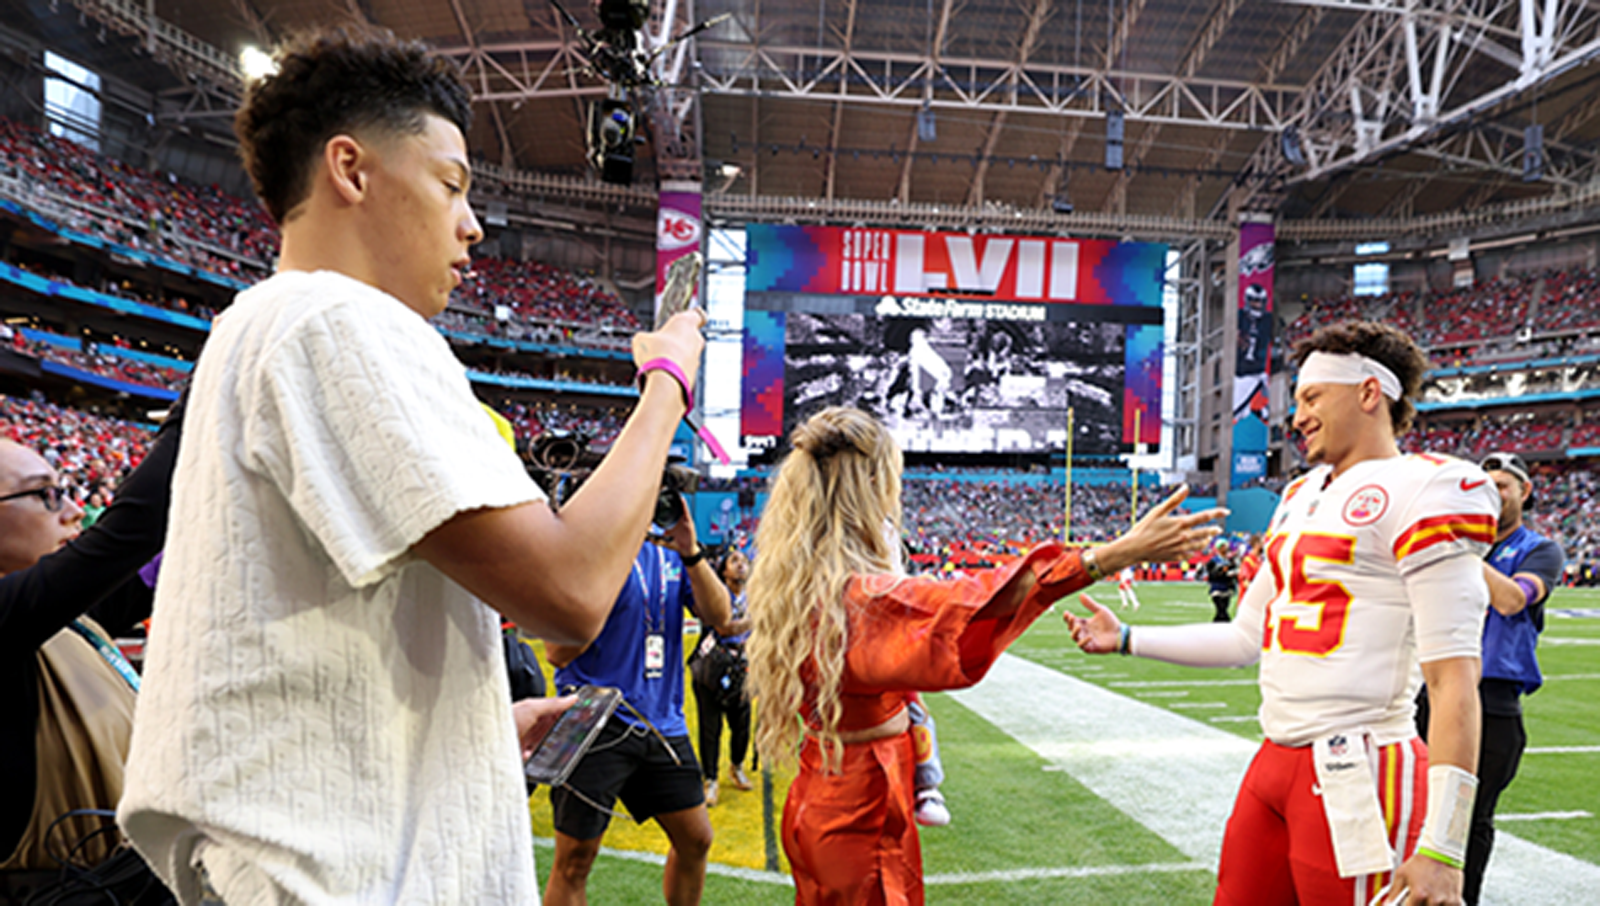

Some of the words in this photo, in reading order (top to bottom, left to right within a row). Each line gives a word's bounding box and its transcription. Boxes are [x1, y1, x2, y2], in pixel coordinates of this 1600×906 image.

[843, 230, 890, 260] SUPER
[841, 260, 888, 292] BOWL
[894, 234, 1079, 299] LVII
[900, 296, 945, 317] State
[945, 298, 984, 319] Farm
[985, 303, 1047, 321] STADIUM
[1262, 531, 1357, 660] 15
